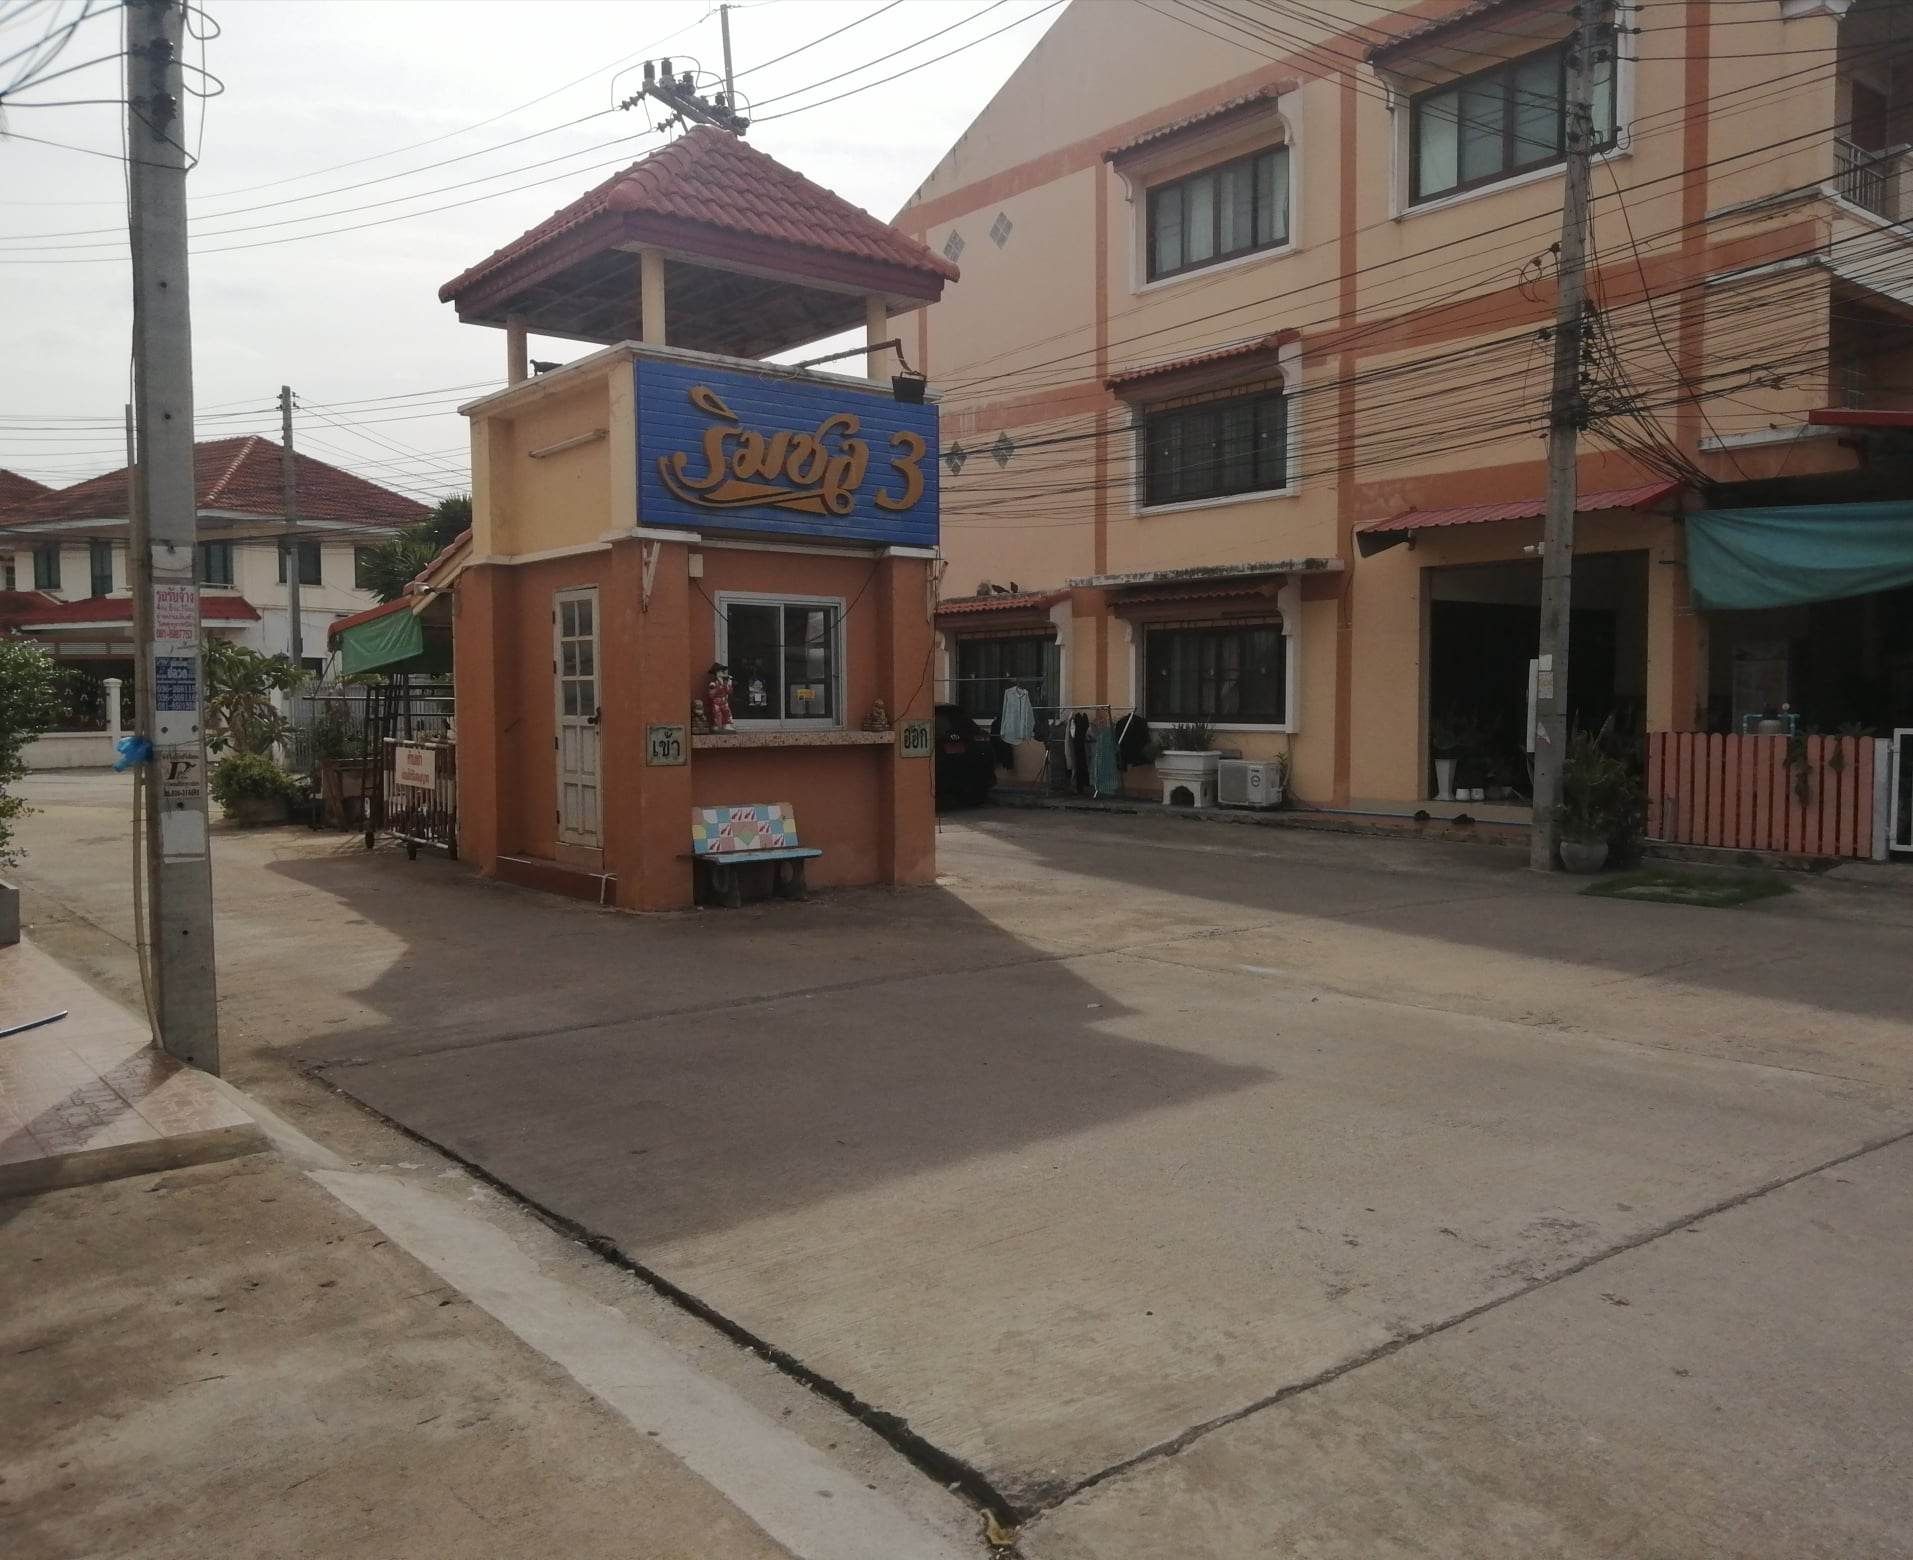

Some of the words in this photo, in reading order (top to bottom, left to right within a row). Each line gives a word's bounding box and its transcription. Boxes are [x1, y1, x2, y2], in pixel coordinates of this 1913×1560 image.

[875, 431, 926, 511] 3
[653, 731, 680, 757] เข้า
[904, 728, 928, 749] ออก
